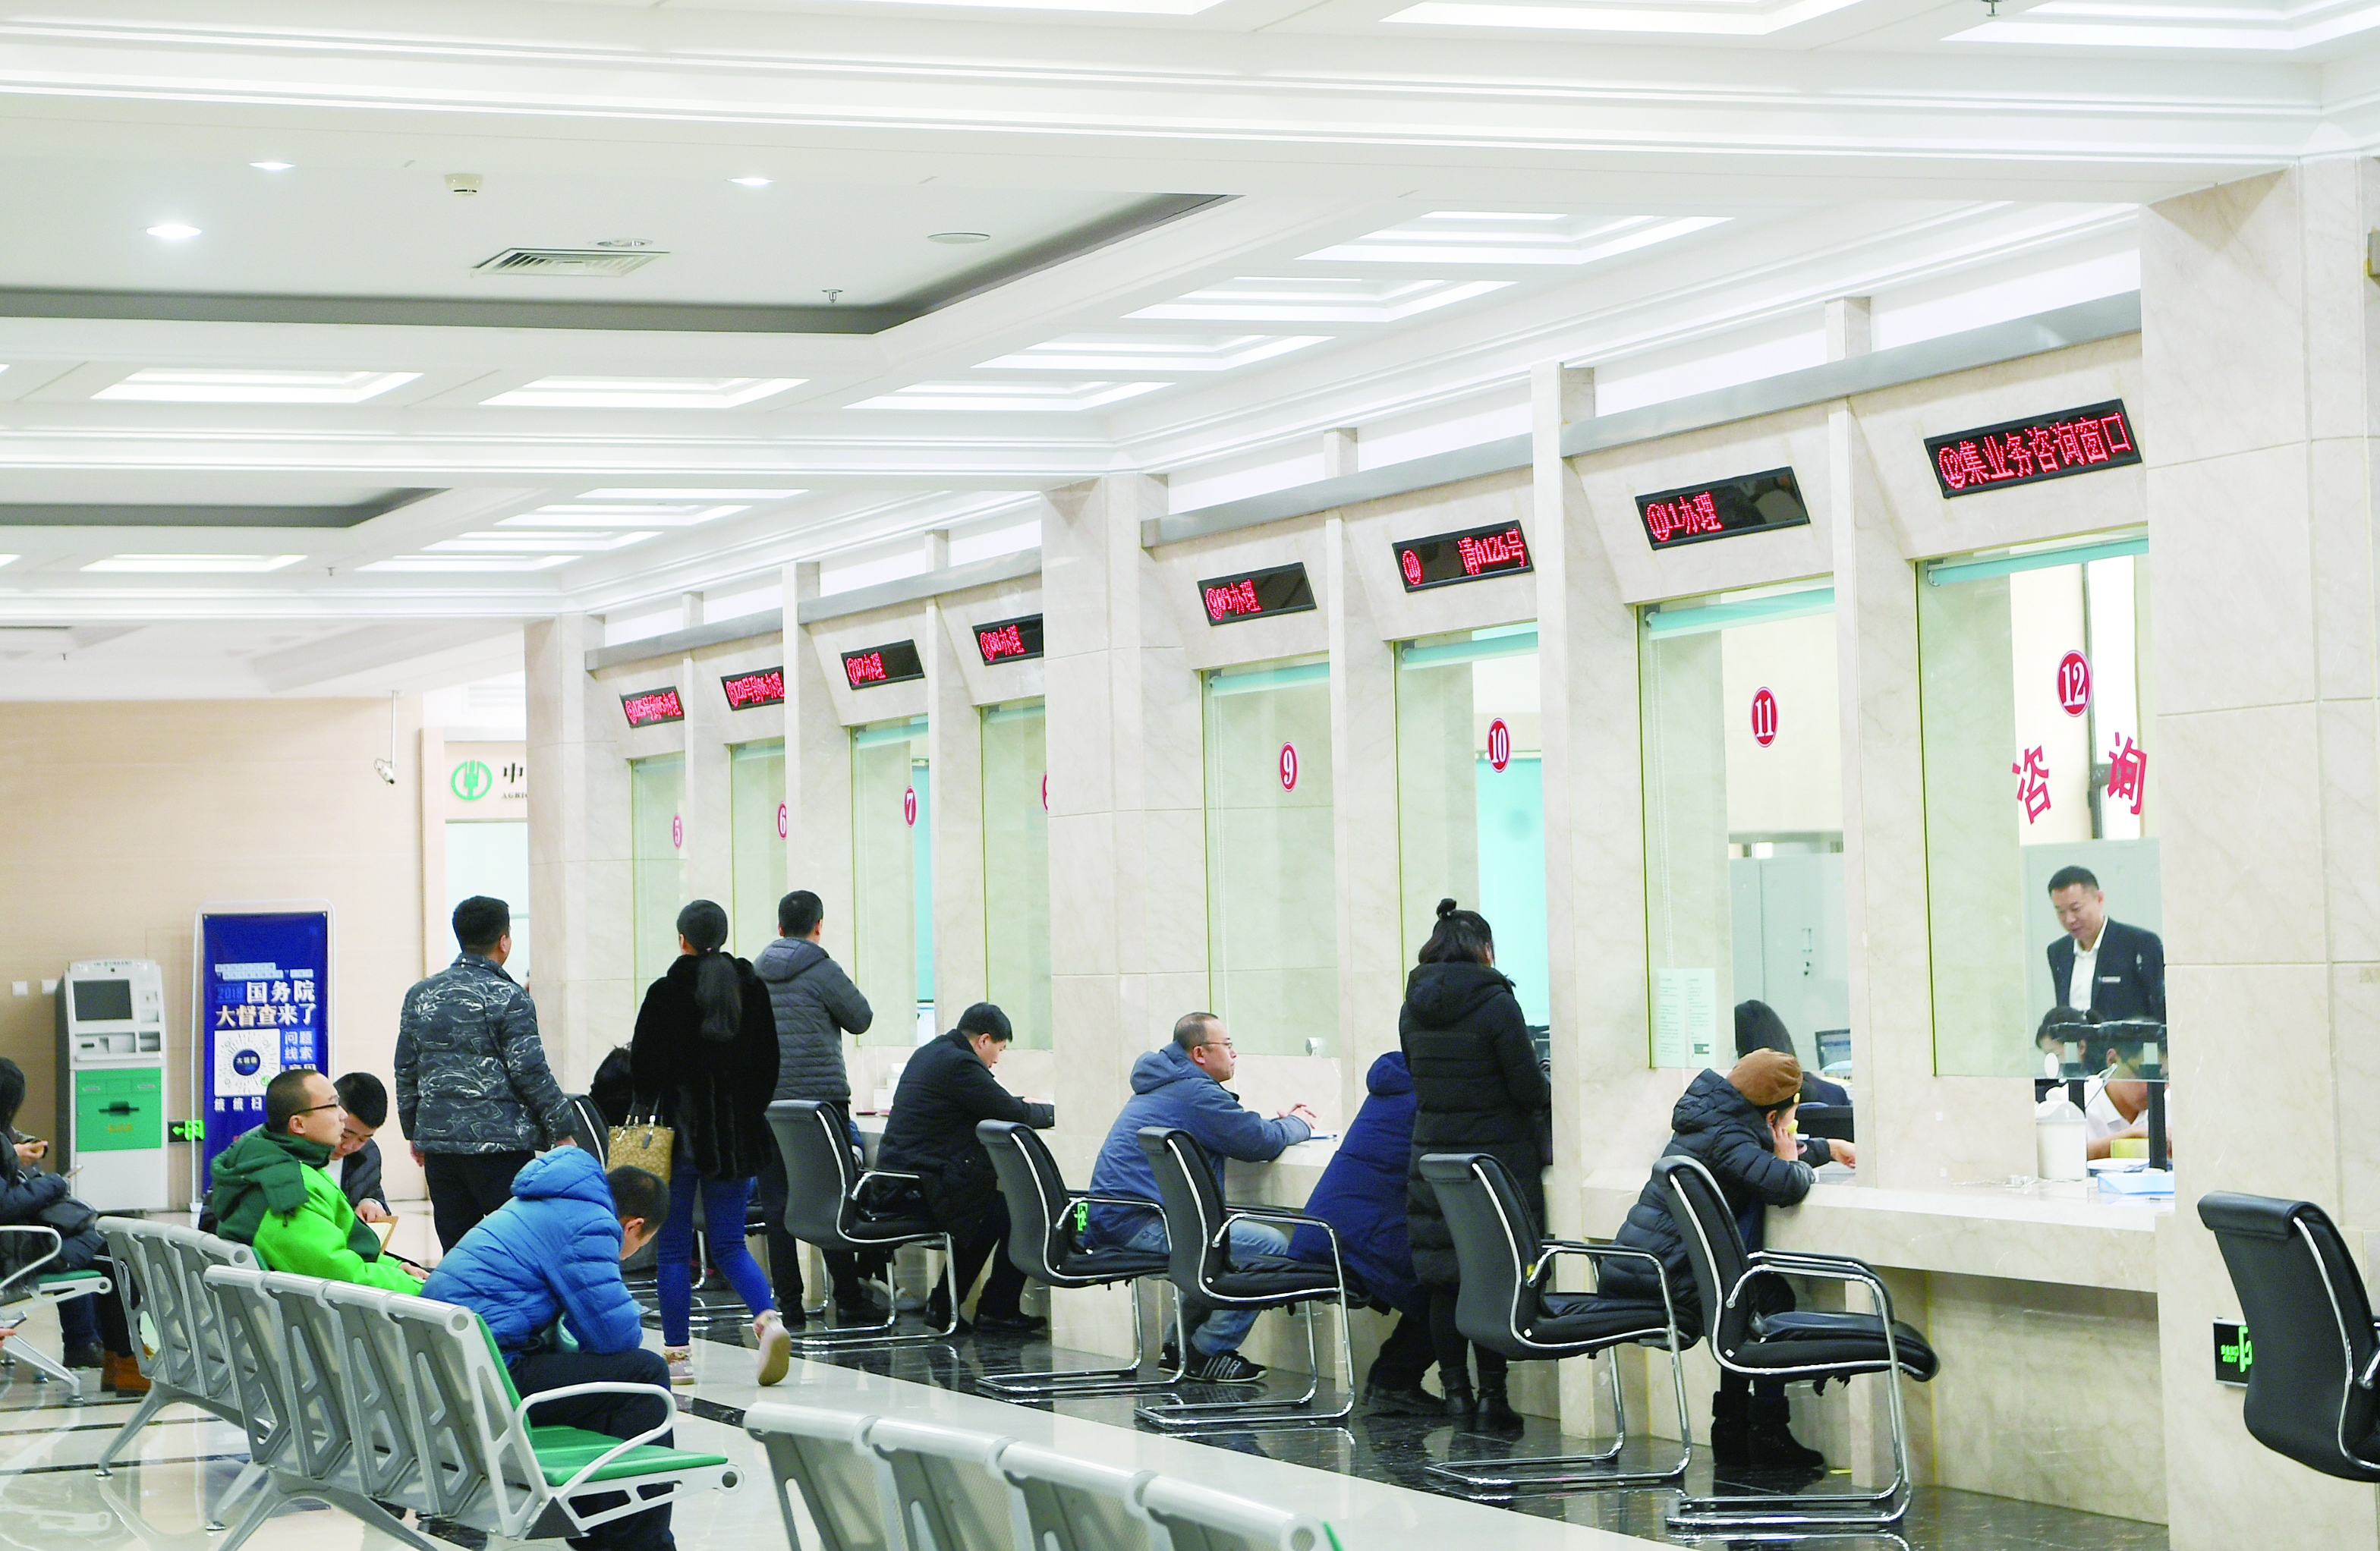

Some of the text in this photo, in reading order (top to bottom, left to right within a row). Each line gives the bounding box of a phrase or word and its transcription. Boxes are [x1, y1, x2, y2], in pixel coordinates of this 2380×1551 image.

[2062, 661, 2086, 707] 12
[1755, 697, 1774, 738] 11
[1491, 727, 1507, 763] 10
[1283, 749, 1294, 785] 9
[779, 807, 787, 835] 6
[906, 792, 914, 821] 7
[674, 819, 681, 844] 5
[247, 980, 316, 1003] 国务院
[216, 1002, 316, 1027] 大督查来了
